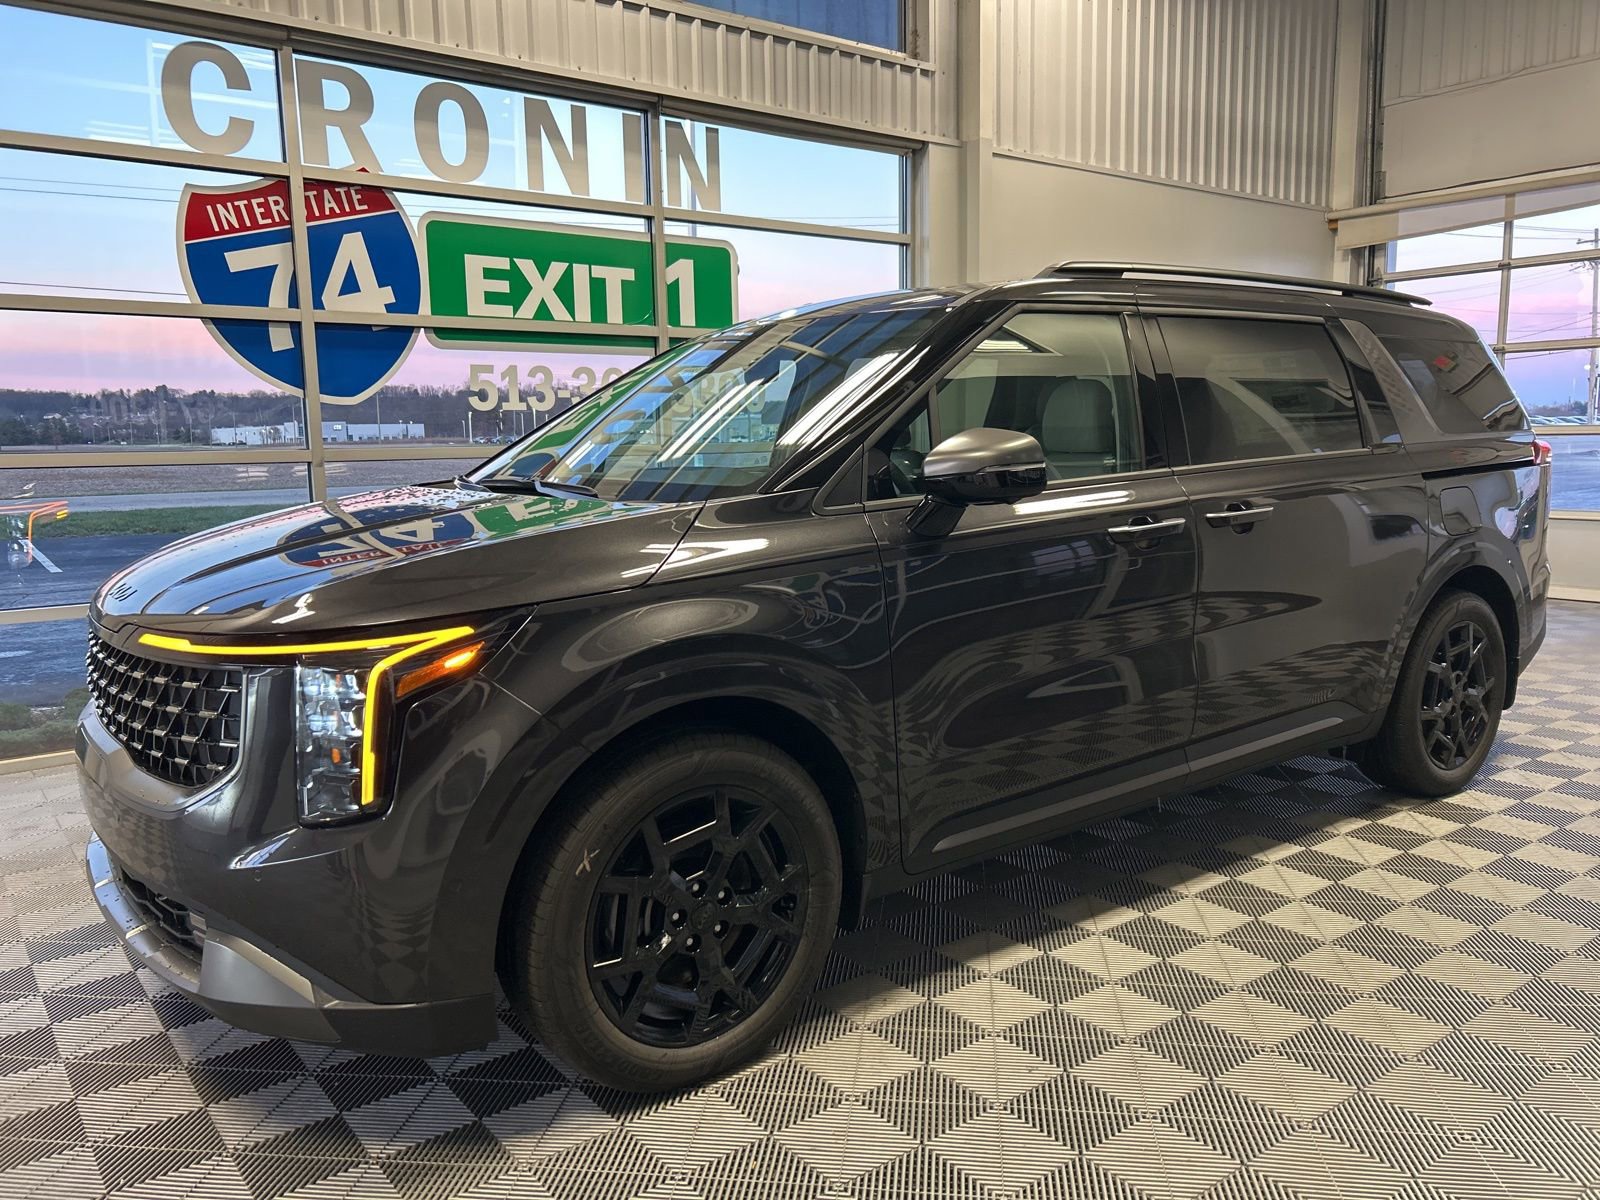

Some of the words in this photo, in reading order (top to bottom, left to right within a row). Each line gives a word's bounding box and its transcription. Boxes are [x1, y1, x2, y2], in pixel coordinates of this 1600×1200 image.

[161, 40, 721, 213] CRONIN
[206, 185, 368, 232] INTERTATE
[224, 231, 396, 352] 74
[464, 253, 635, 325] EXIT
[665, 258, 696, 327] 1
